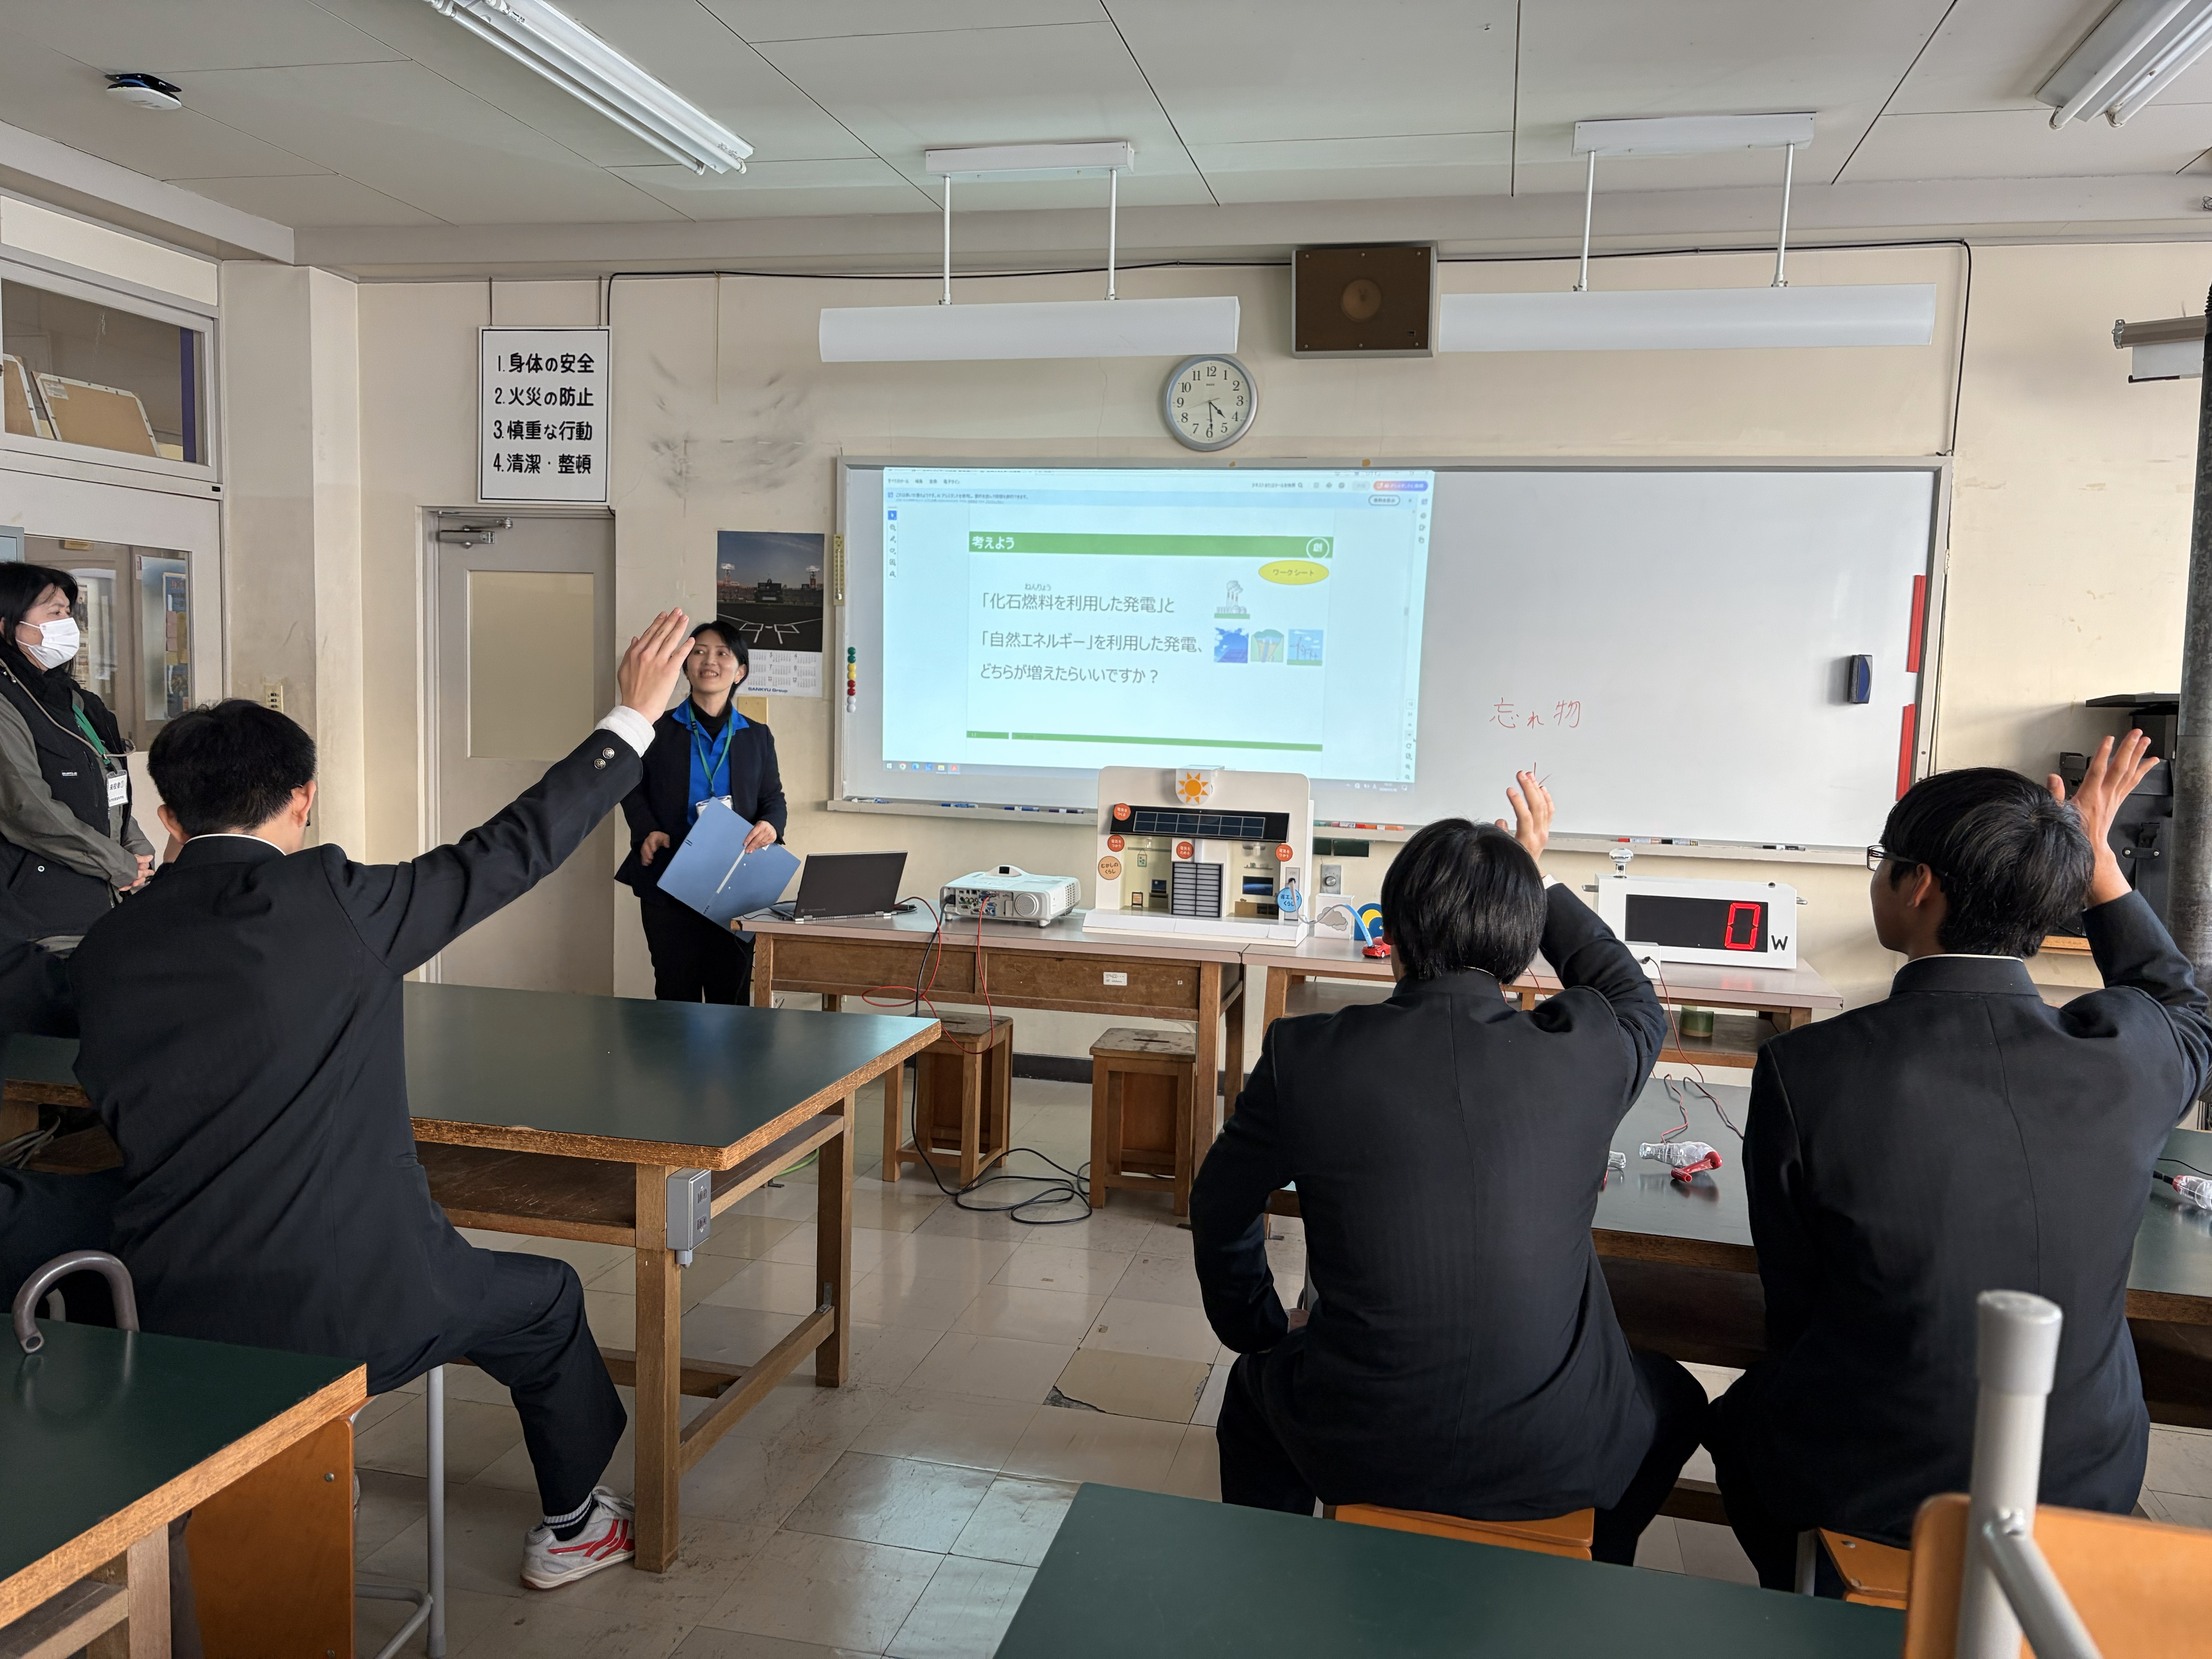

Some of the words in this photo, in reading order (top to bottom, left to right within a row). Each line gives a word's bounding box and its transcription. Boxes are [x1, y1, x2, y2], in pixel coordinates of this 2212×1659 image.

[498, 352, 595, 373] 1.身体の安全
[1192, 370, 1201, 381] 11
[1206, 366, 1217, 377] 12
[1223, 370, 1228, 380] 1
[1181, 382, 1192, 392] 10
[1232, 380, 1240, 391] 2
[495, 386, 594, 407] 2.火災の防止
[1236, 395, 1243, 406] 3
[1177, 397, 1184, 408] 9
[1181, 412, 1188, 423] 8
[1231, 411, 1238, 422] 4
[493, 419, 593, 441] 3.慎重な行動
[1192, 423, 1199, 434] 7
[1206, 426, 1213, 438] 6
[1221, 423, 1228, 433] 5
[972, 536, 1015, 550] 考えよう
[1273, 568, 1314, 577] ワークシート
[1025, 583, 1051, 591] ねんりょう
[983, 592, 1175, 613] 「化石燃料を利用した発電」と
[982, 631, 1202, 653] 「自然エネルギー」を利用した発電、
[981, 663, 1158, 684] どちらが増えたらいいですか？
[1490, 697, 1580, 729] 忘れ物
[1724, 902, 1761, 950] 0
[1771, 935, 1788, 951] W
